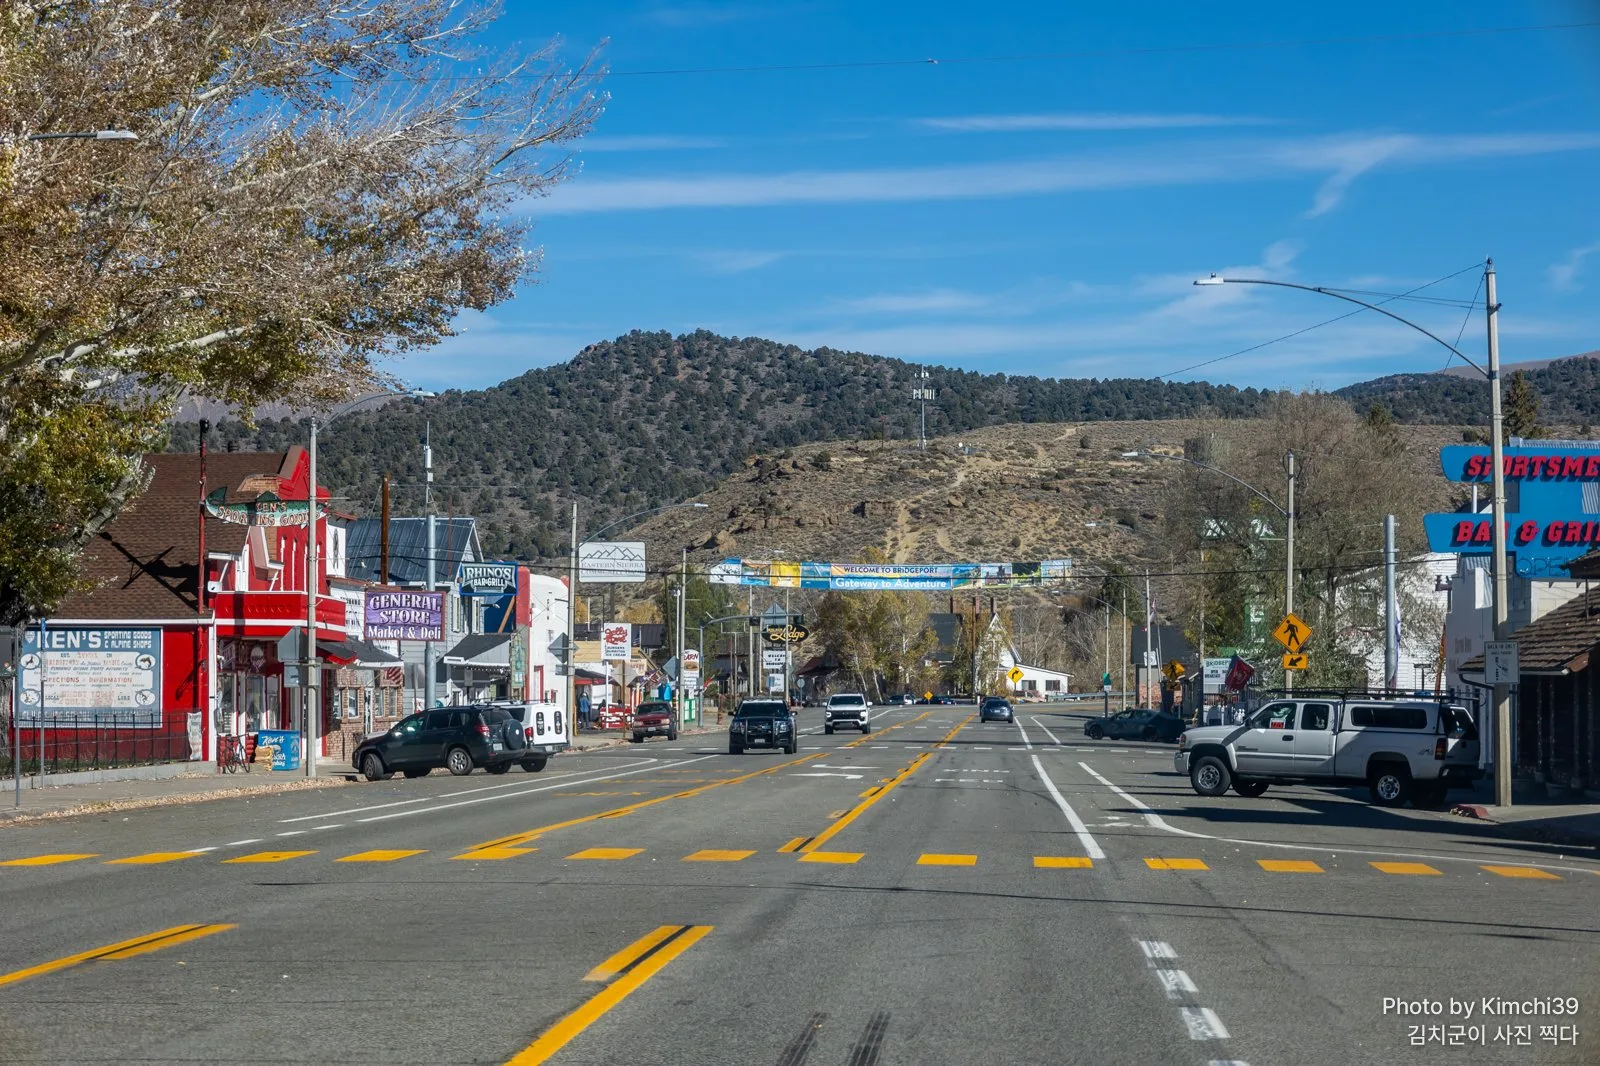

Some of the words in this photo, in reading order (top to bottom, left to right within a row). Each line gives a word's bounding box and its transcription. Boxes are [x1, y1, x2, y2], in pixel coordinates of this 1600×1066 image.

[1520, 520, 1540, 542] &
[466, 567, 511, 580] RHINO'S
[844, 566, 879, 574] WELCOME
[893, 566, 938, 574] BRIDGEPORT
[835, 577, 877, 589] Gateway
[881, 579, 891, 588] to
[894, 578, 947, 588] Adventure
[369, 594, 440, 611] GENERAL
[380, 610, 430, 625] STORE
[103, 631, 131, 640] SPORTING
[132, 631, 152, 640] GOODS
[368, 626, 404, 638] Market
[407, 626, 416, 639] &
[420, 627, 440, 639] Deli
[36, 630, 102, 649] KEN'S
[110, 640, 131, 649] ALPINE
[132, 640, 152, 649] SHOPS
